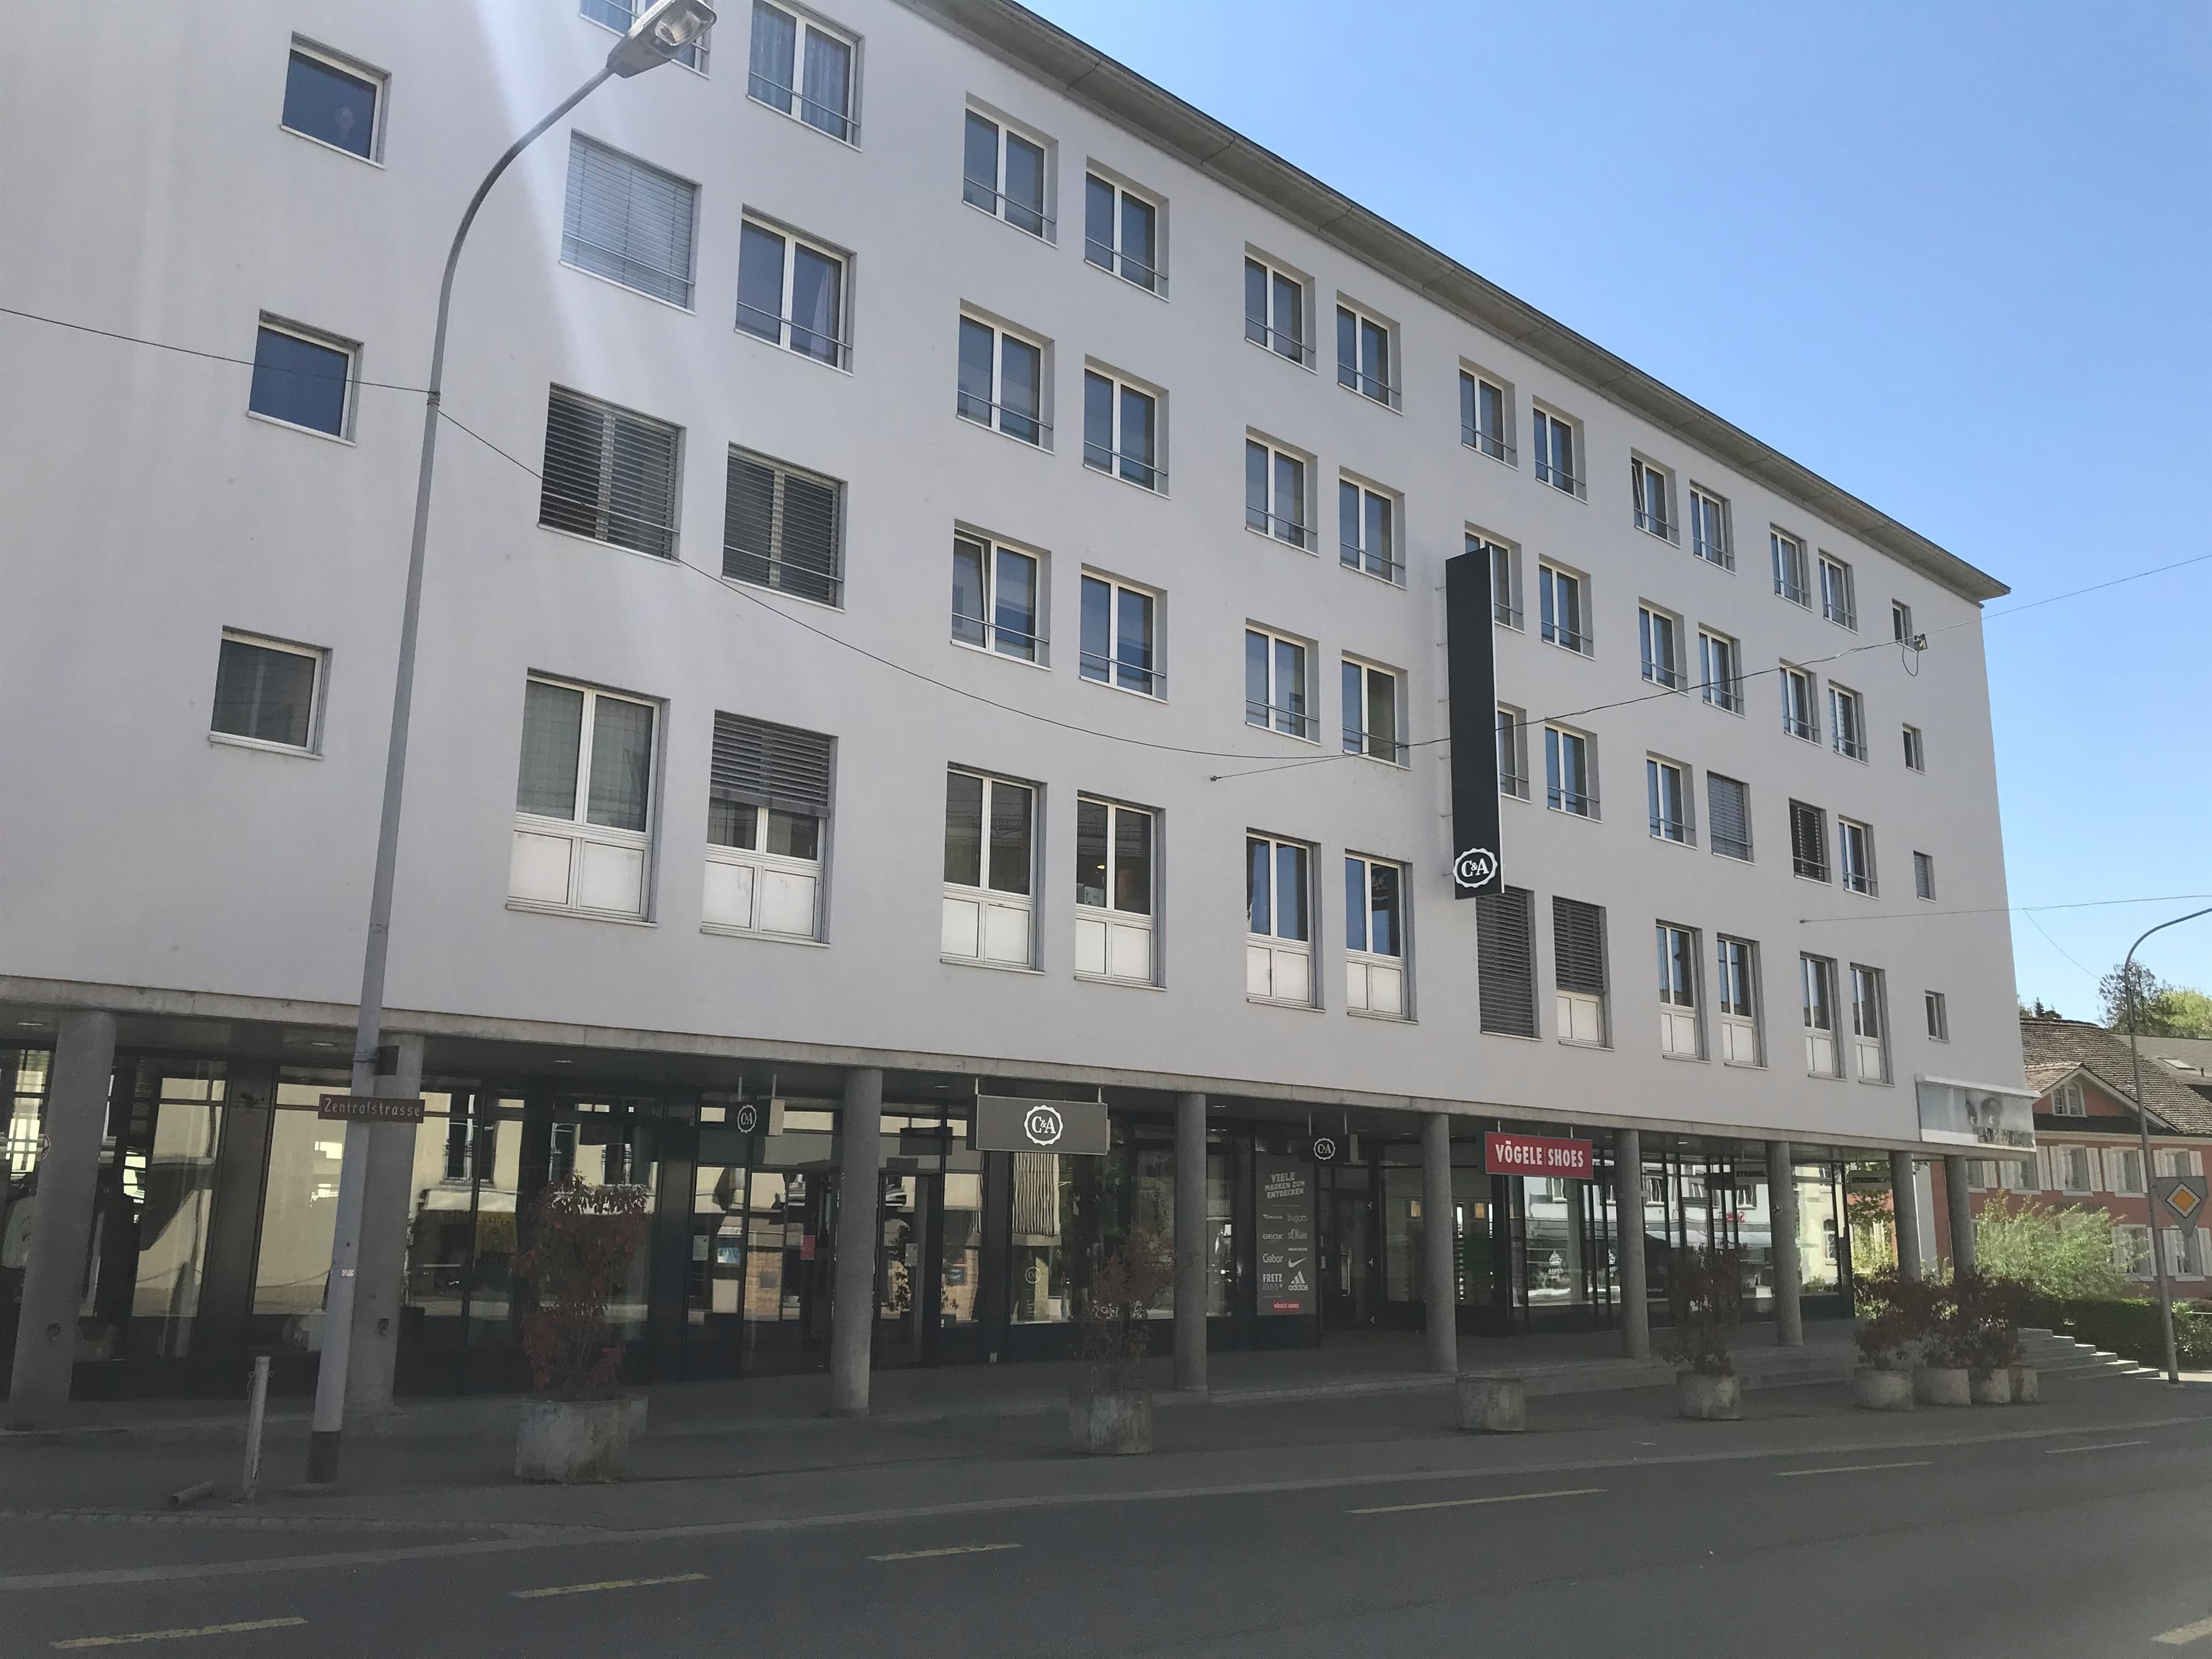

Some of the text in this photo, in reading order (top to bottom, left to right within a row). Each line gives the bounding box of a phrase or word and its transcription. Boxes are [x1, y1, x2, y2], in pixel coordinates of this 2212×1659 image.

[1461, 858, 1490, 877] C&A
[324, 1097, 421, 1116] Zentralstrasse
[741, 1112, 753, 1125] C&A
[1031, 1116, 1056, 1134] C&A
[1317, 1144, 1332, 1154] C&A
[1495, 1140, 1584, 1168] VÖGELE SHOES
[1271, 1172, 1296, 1183] VIELE
[1264, 1180, 1305, 1191] MARKEN ZUM
[1267, 1187, 1304, 1199] ENTDECKEN
[1262, 1253, 1284, 1263] Gabor
[1262, 1274, 1283, 1283] FRETZ
